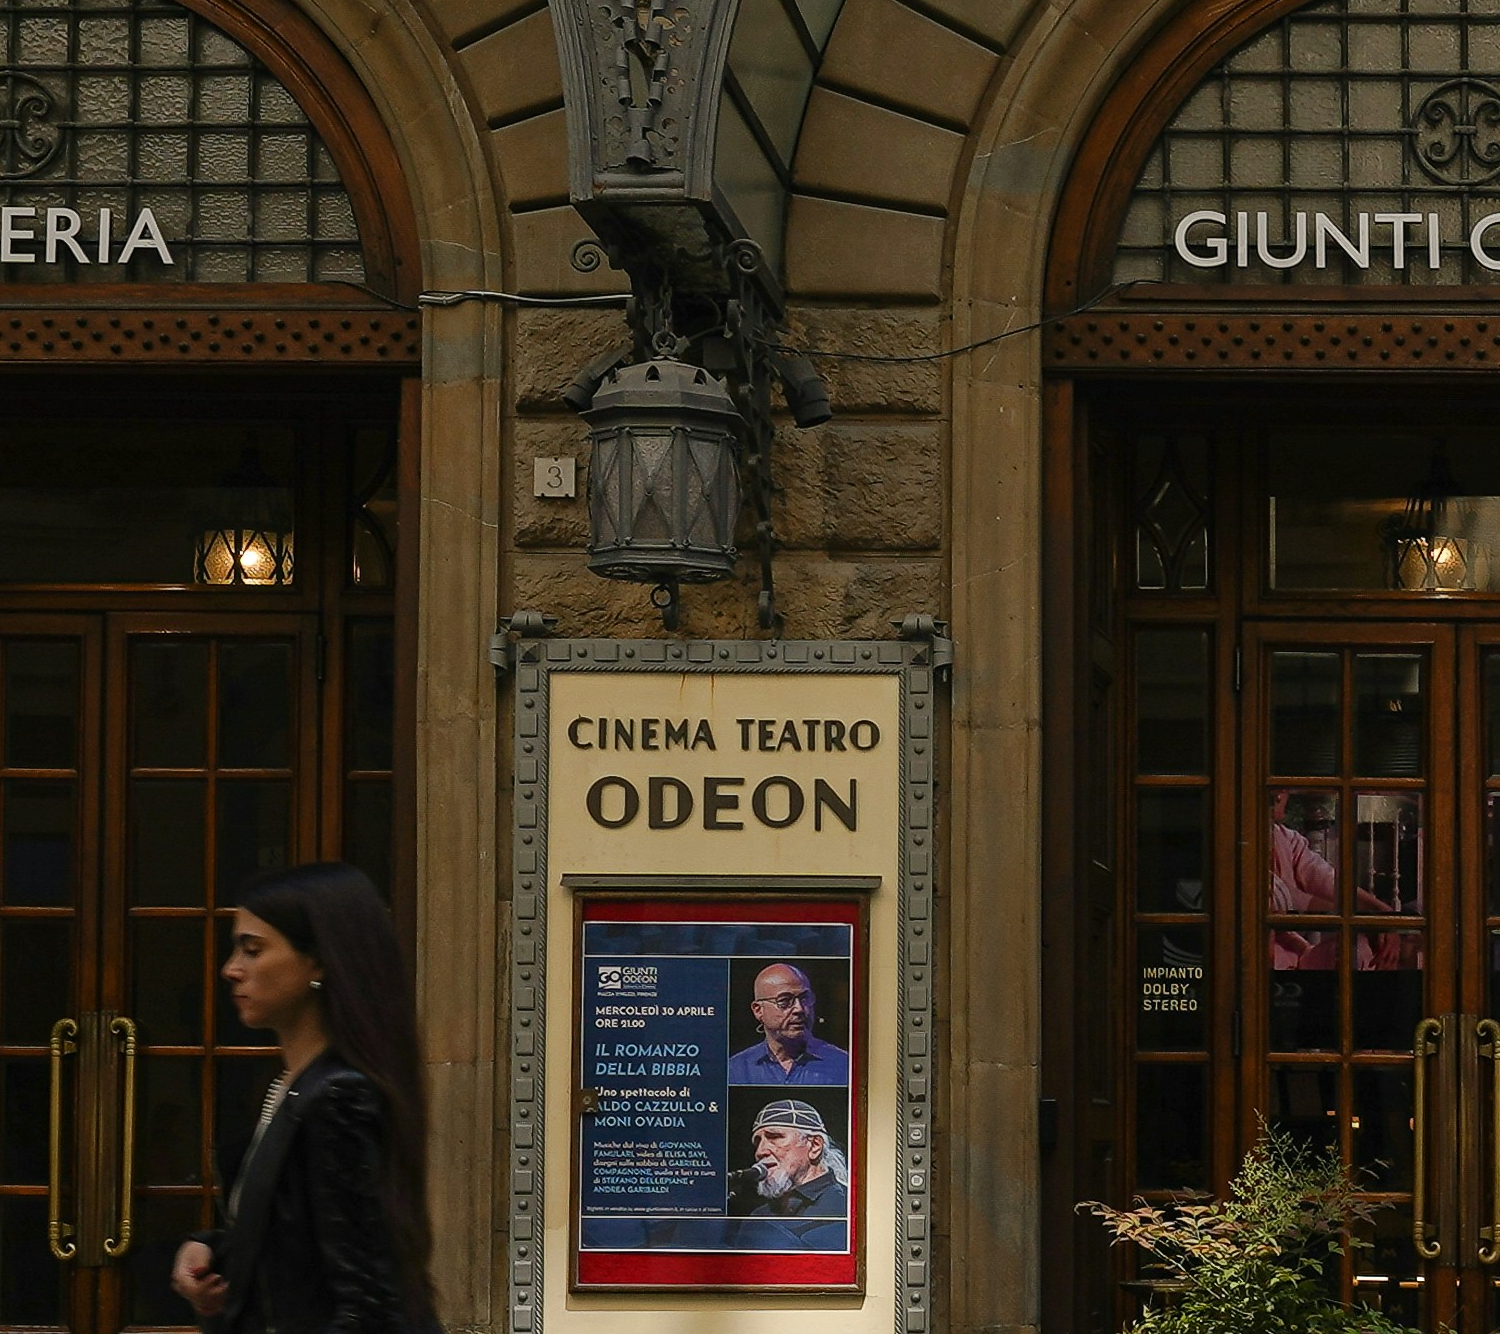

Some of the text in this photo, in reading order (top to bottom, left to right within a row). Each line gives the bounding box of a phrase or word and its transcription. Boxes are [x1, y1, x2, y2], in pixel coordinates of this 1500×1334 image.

[1174, 210, 1439, 269] GIUNTI
[546, 465, 563, 489] 3
[567, 717, 880, 753] CINEMA TEATRO
[585, 774, 858, 832] ODEON
[622, 967, 658, 975] GIUNTI
[1143, 967, 1203, 979] IMPIANTO
[622, 975, 658, 983] ODEON
[1143, 983, 1190, 995] DOLBY
[595, 1005, 715, 1016] MERCOLEDÌ 30 APRILE
[1143, 999, 1198, 1012] STEREO
[595, 1019, 618, 1028] ORE
[595, 1044, 699, 1057] IL ROMANZO
[595, 1063, 701, 1076] DELLA BIBBIA
[620, 1087, 676, 1099] spettacolo
[679, 1086, 690, 1097] di
[635, 1101, 705, 1112] CAZZULLO
[708, 1101, 719, 1113] &
[595, 1116, 686, 1127] MONI OVADIA
